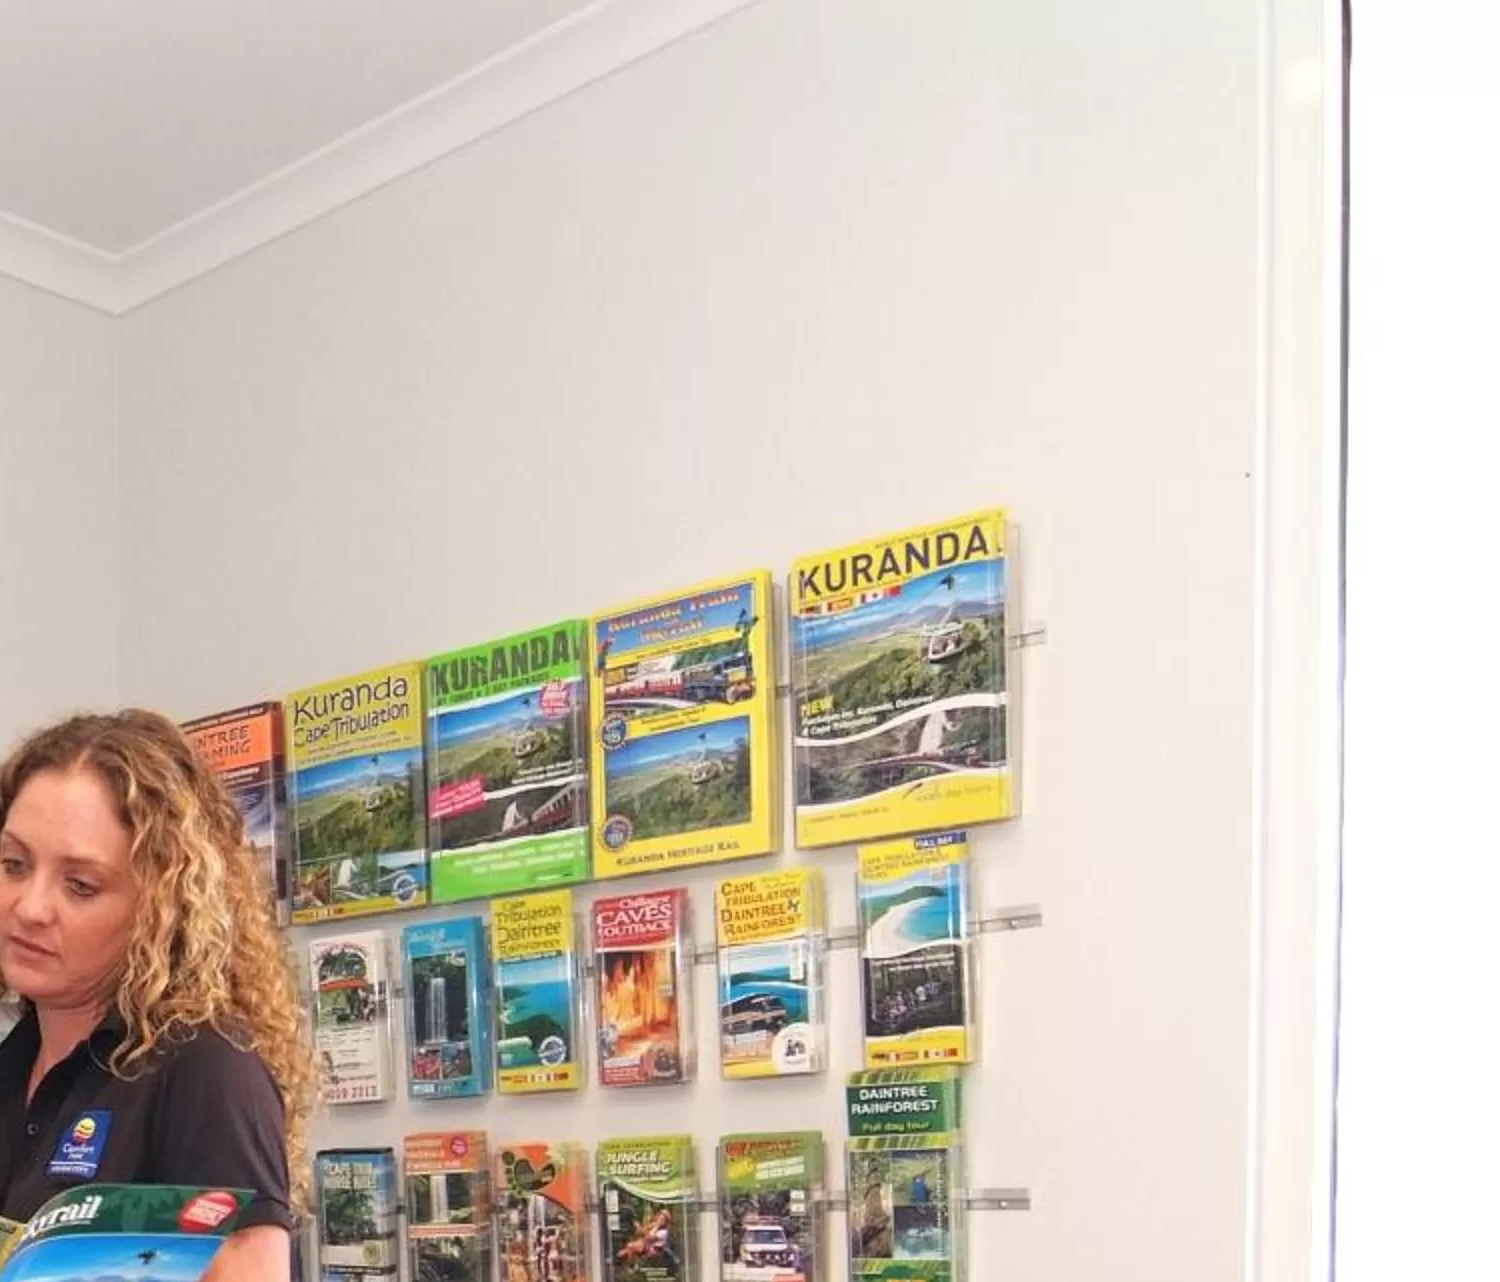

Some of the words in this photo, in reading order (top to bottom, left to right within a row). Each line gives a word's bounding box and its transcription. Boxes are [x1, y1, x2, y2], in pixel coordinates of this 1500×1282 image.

[800, 525, 988, 598] KURANDA
[431, 630, 570, 698] KURANDA
[295, 676, 408, 727] Kuranda
[196, 725, 250, 747] NTREE
[294, 723, 330, 748] Cape
[331, 703, 409, 740] Tribulation
[722, 880, 756, 897] CAPE
[596, 903, 672, 926] CAVES
[859, 1086, 929, 1101] DAINTREE
[852, 1100, 938, 1115] RAINFOREST
[607, 1151, 659, 1164] JUNGLE
[608, 1162, 672, 1176] SURFING
[24, 1195, 103, 1238] yrail
